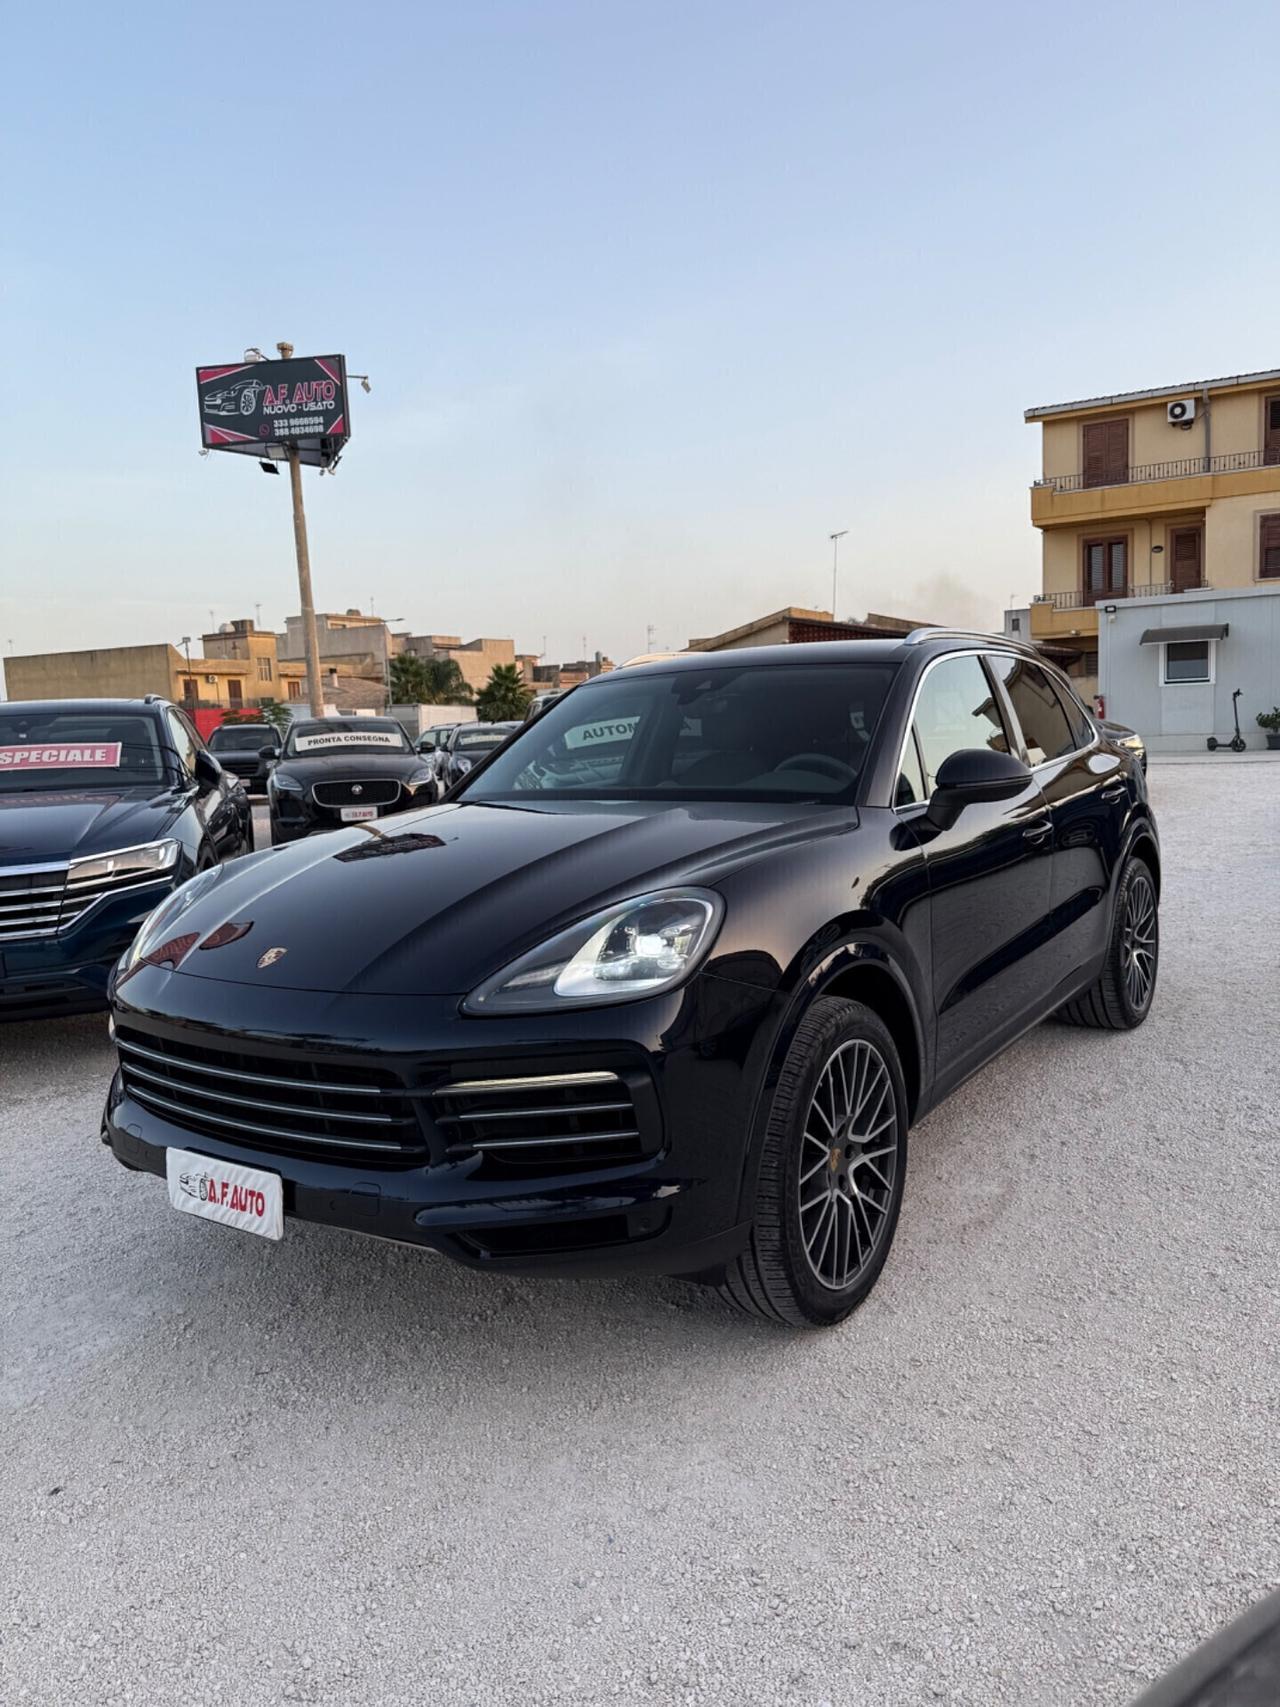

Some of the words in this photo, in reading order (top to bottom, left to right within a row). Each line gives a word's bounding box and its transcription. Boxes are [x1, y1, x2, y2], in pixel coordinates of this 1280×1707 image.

[292, 380, 336, 404] AUTO
[263, 404, 297, 415] NUOVO
[303, 400, 335, 411] USATO
[307, 736, 342, 746] PRONTA
[343, 735, 391, 743] CONSEGNA
[0, 749, 106, 765] SPECIALE
